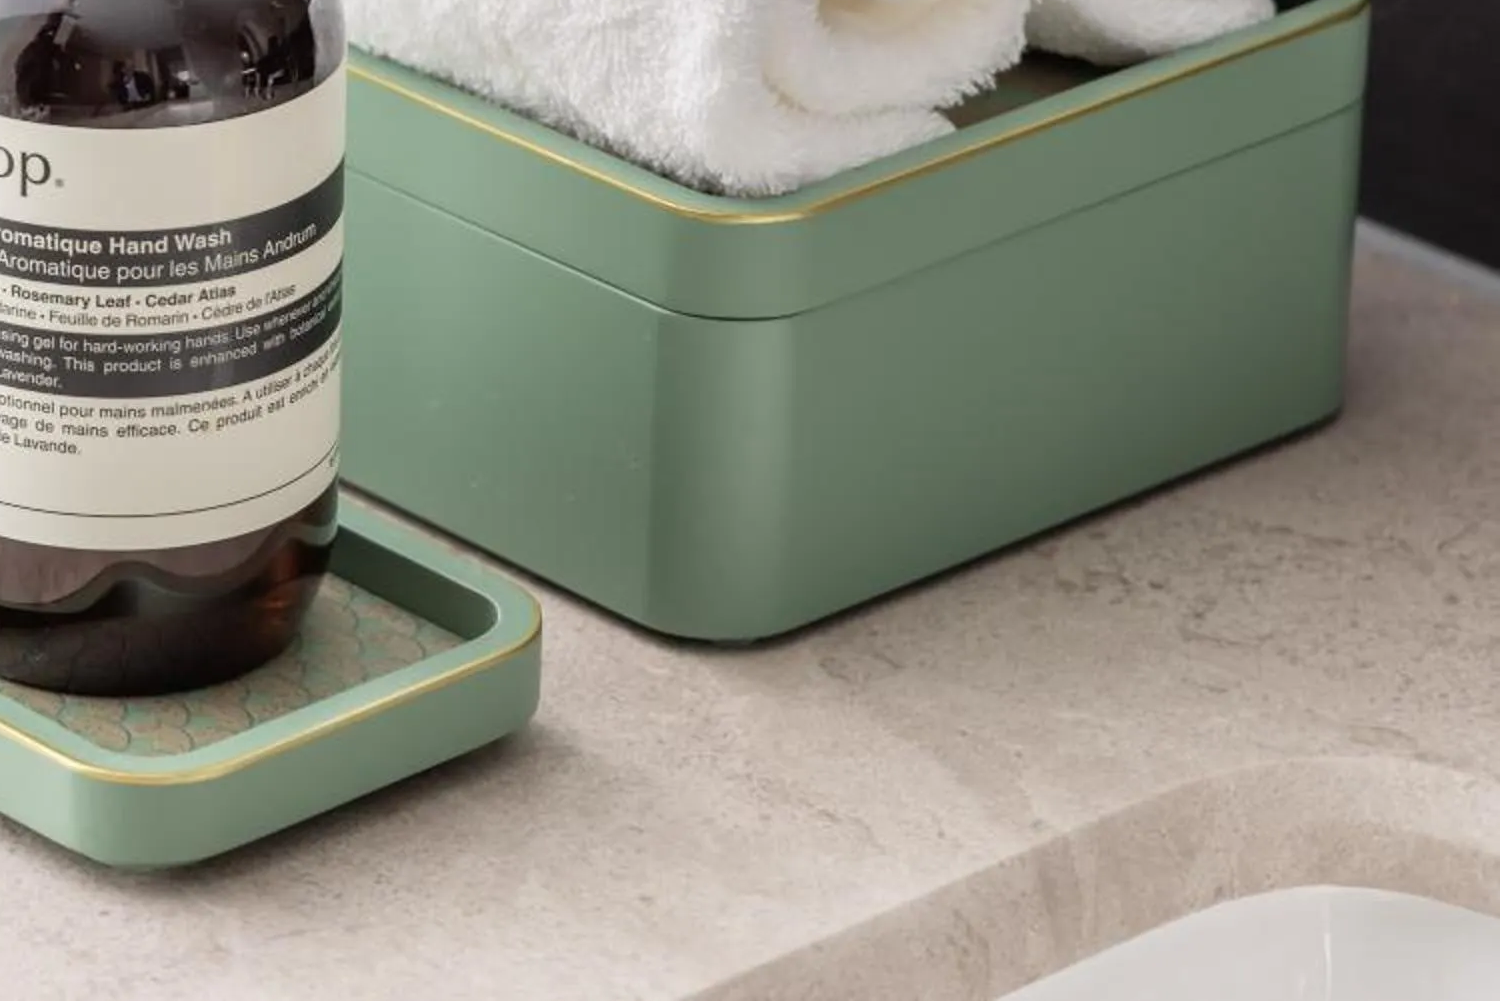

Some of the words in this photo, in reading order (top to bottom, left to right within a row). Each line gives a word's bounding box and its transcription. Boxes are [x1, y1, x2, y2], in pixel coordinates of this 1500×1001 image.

[108, 235, 169, 255] Hand
[174, 228, 232, 252] Wash
[117, 264, 165, 285] pour
[169, 259, 199, 278] les
[204, 247, 259, 273] Mains
[263, 222, 318, 260] Andrum
[10, 283, 91, 310] Rosemary
[96, 294, 132, 309] Leaf
[145, 292, 193, 308] Cedar
[197, 284, 237, 302] Atlas
[49, 309, 99, 327] Feuille
[102, 313, 121, 328] de
[126, 311, 189, 328] Romarin
[246, 296, 263, 311] de
[32, 336, 55, 352] gel
[60, 335, 79, 352] for
[83, 337, 181, 354] hard-working
[235, 323, 261, 340] Use
[63, 356, 95, 372] This
[103, 358, 162, 375] product
[169, 357, 181, 370] is
[190, 341, 258, 368] enhanced
[264, 333, 286, 351] with
[60, 404, 95, 419] pour
[99, 405, 147, 419] mains
[255, 375, 293, 399] utiliser
[35, 418, 55, 433] de
[61, 423, 109, 438] mains
[116, 423, 181, 438] efficace.
[188, 418, 210, 433] Ce
[215, 404, 263, 432] produit
[267, 396, 285, 414] est
[13, 433, 82, 455] Lavande.
